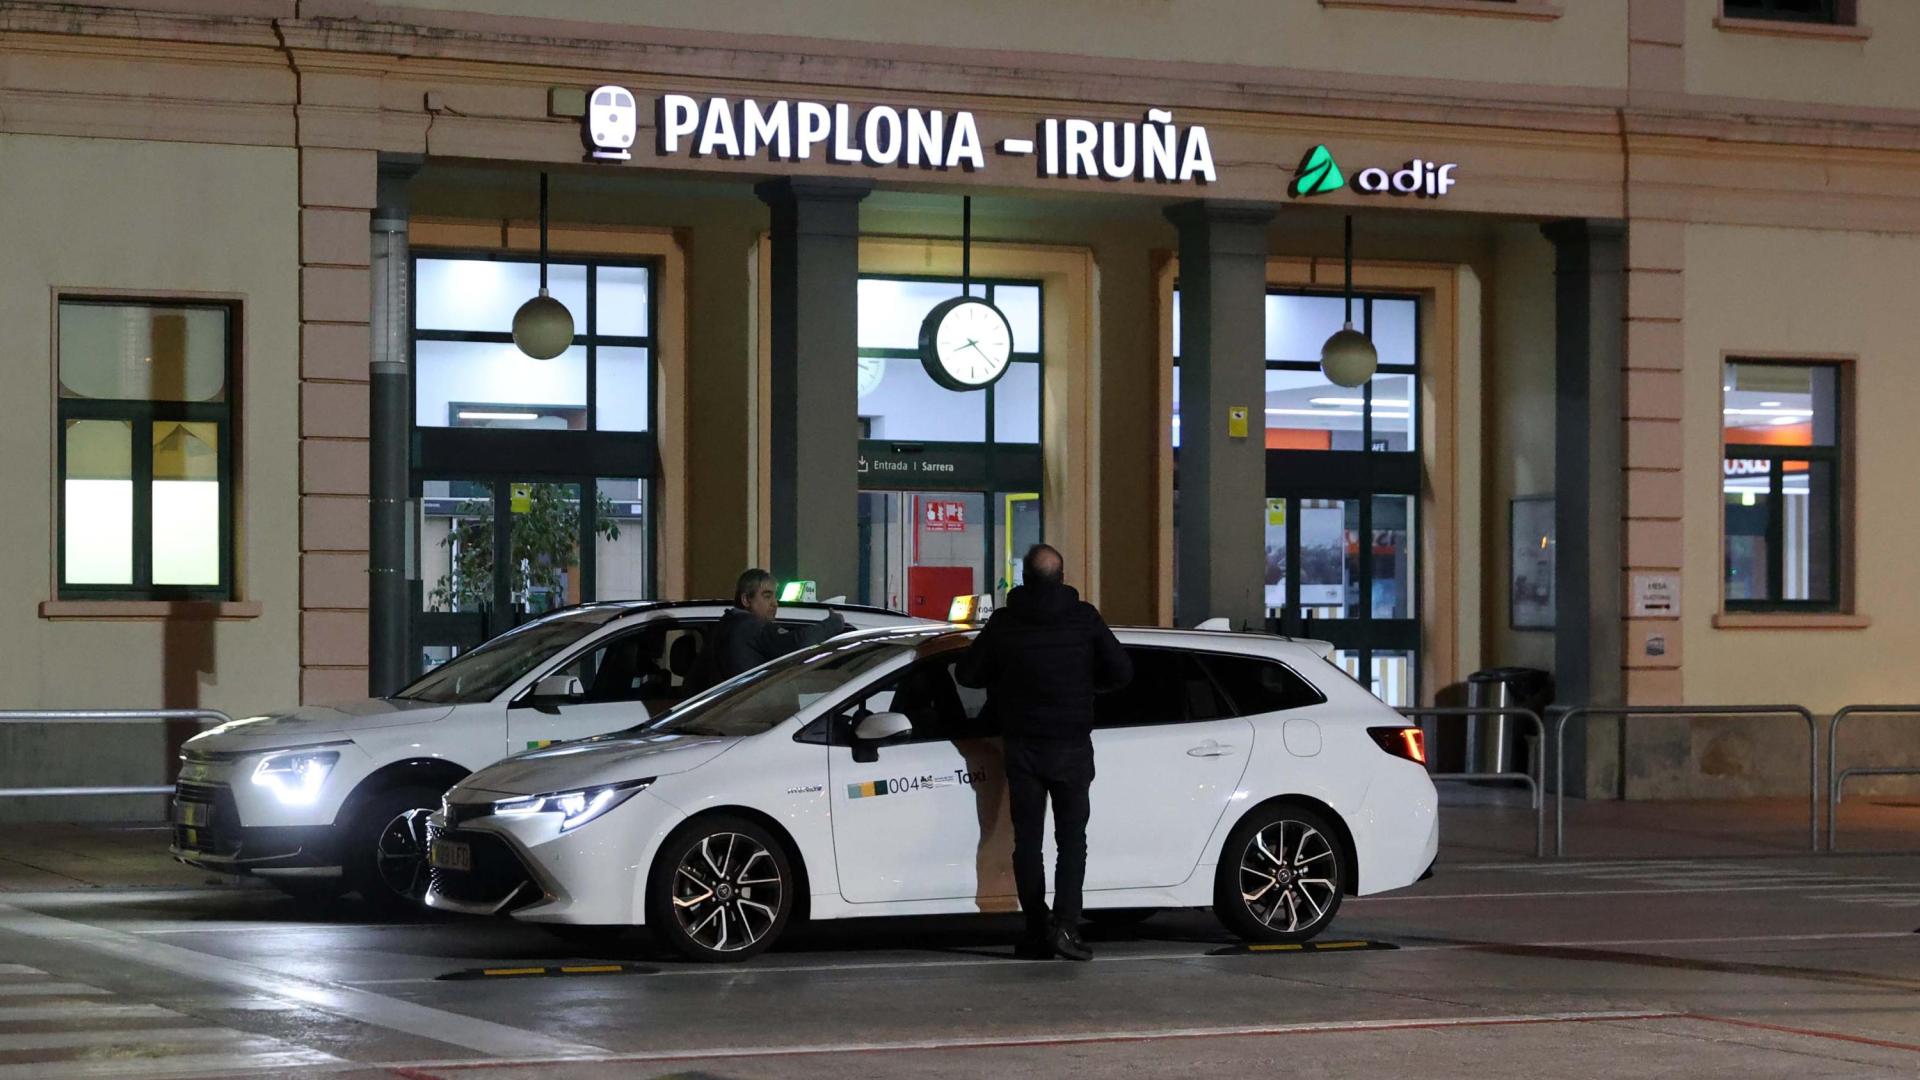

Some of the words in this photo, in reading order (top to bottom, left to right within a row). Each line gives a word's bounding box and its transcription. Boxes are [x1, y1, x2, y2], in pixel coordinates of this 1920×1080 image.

[663, 95, 985, 168] PAMPLONA
[1358, 159, 1457, 195] adif
[874, 460, 908, 471] Entrada
[922, 461, 955, 472] Sarrera
[889, 775, 919, 794] 004
[954, 767, 986, 785] Taxi
